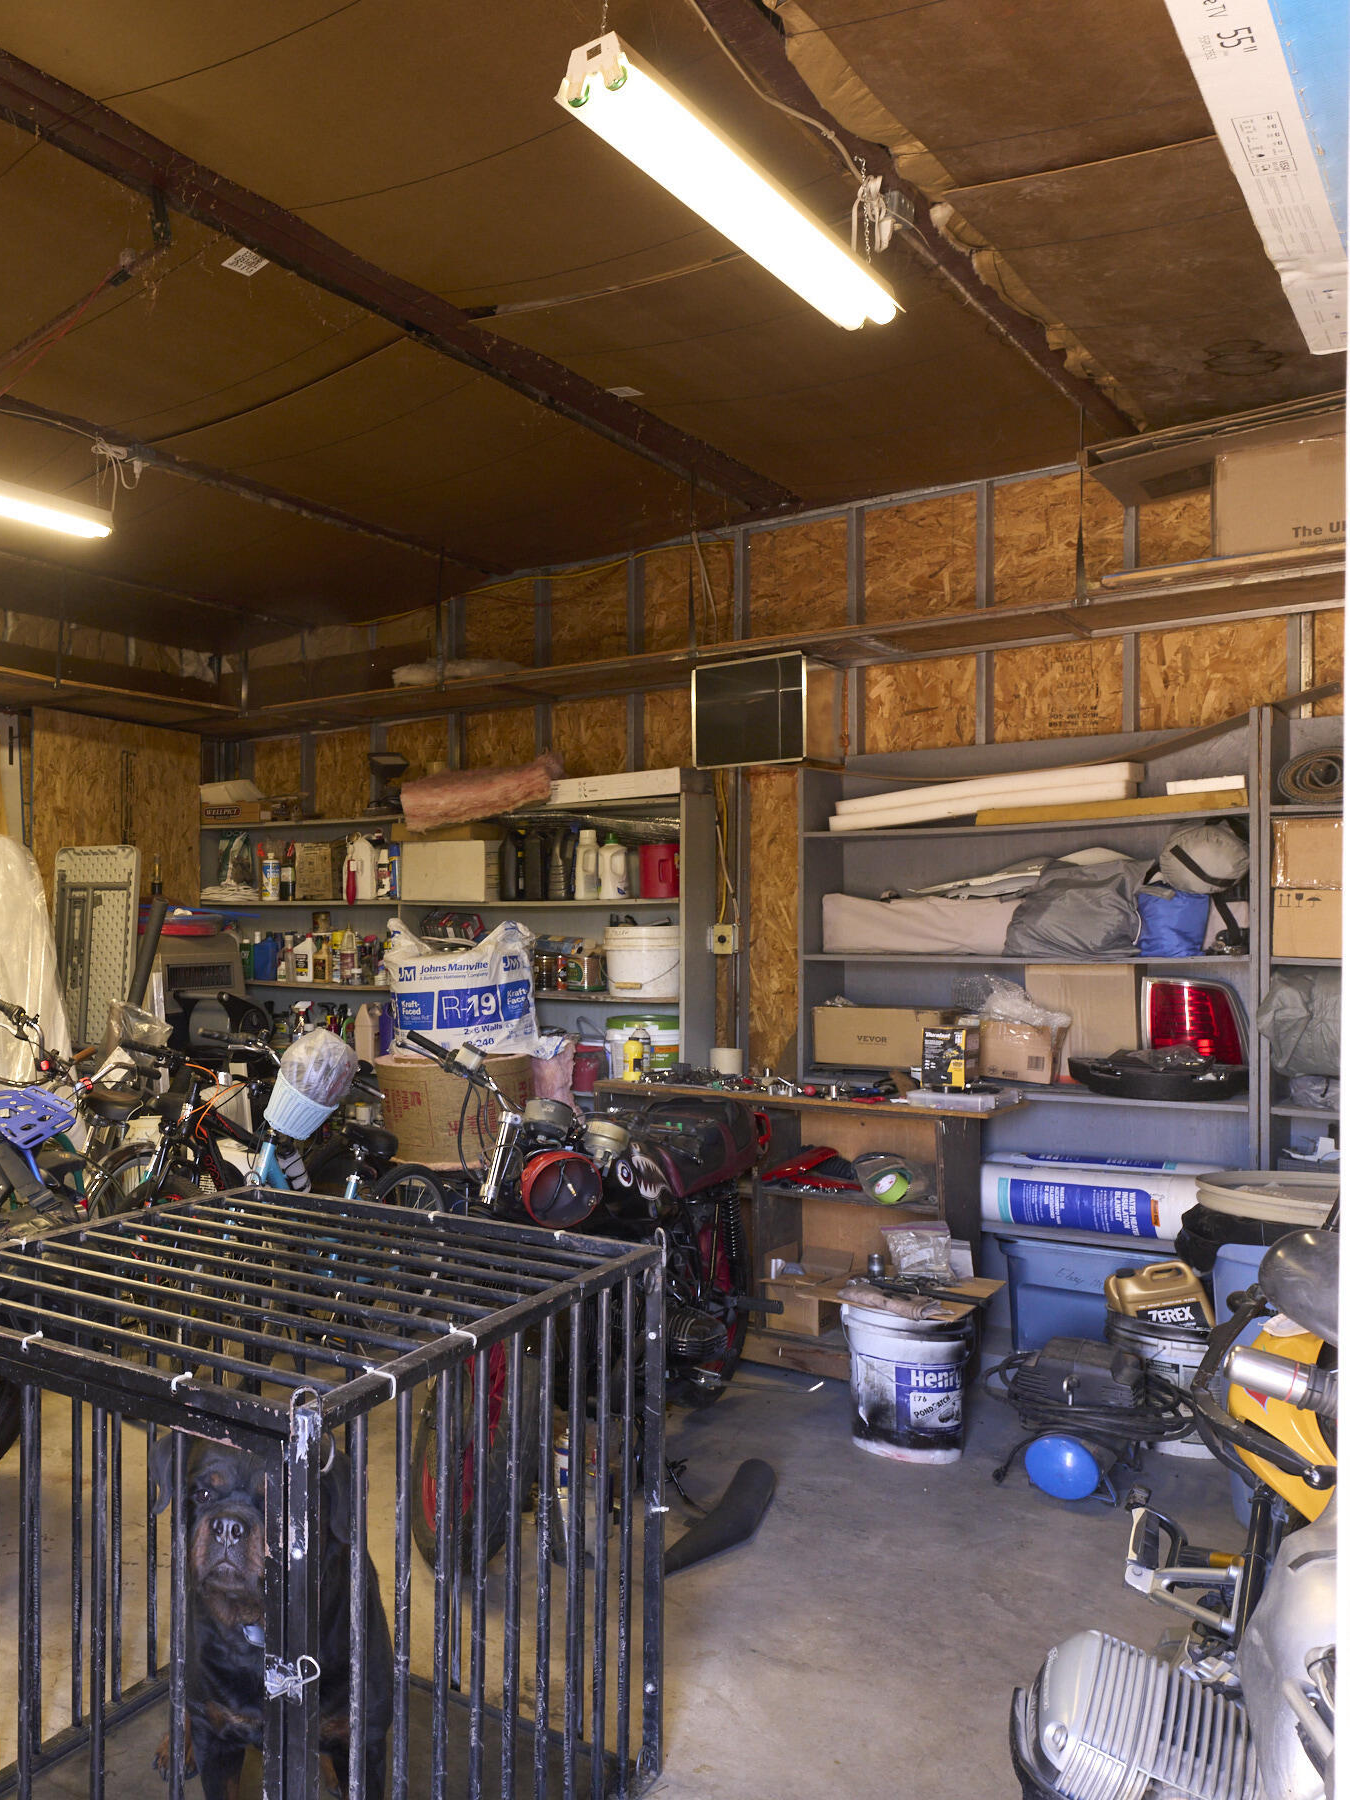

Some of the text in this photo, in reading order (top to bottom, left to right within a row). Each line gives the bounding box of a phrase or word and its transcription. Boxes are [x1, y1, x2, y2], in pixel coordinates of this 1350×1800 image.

[1292, 525, 1323, 539] The
[420, 961, 489, 975] Johns Manville
[402, 1007, 421, 1016] Faced
[441, 992, 497, 1020] R-19
[481, 1024, 503, 1033] Walls
[857, 1035, 888, 1044] VEVOR
[1122, 1192, 1130, 1228] INSULATION
